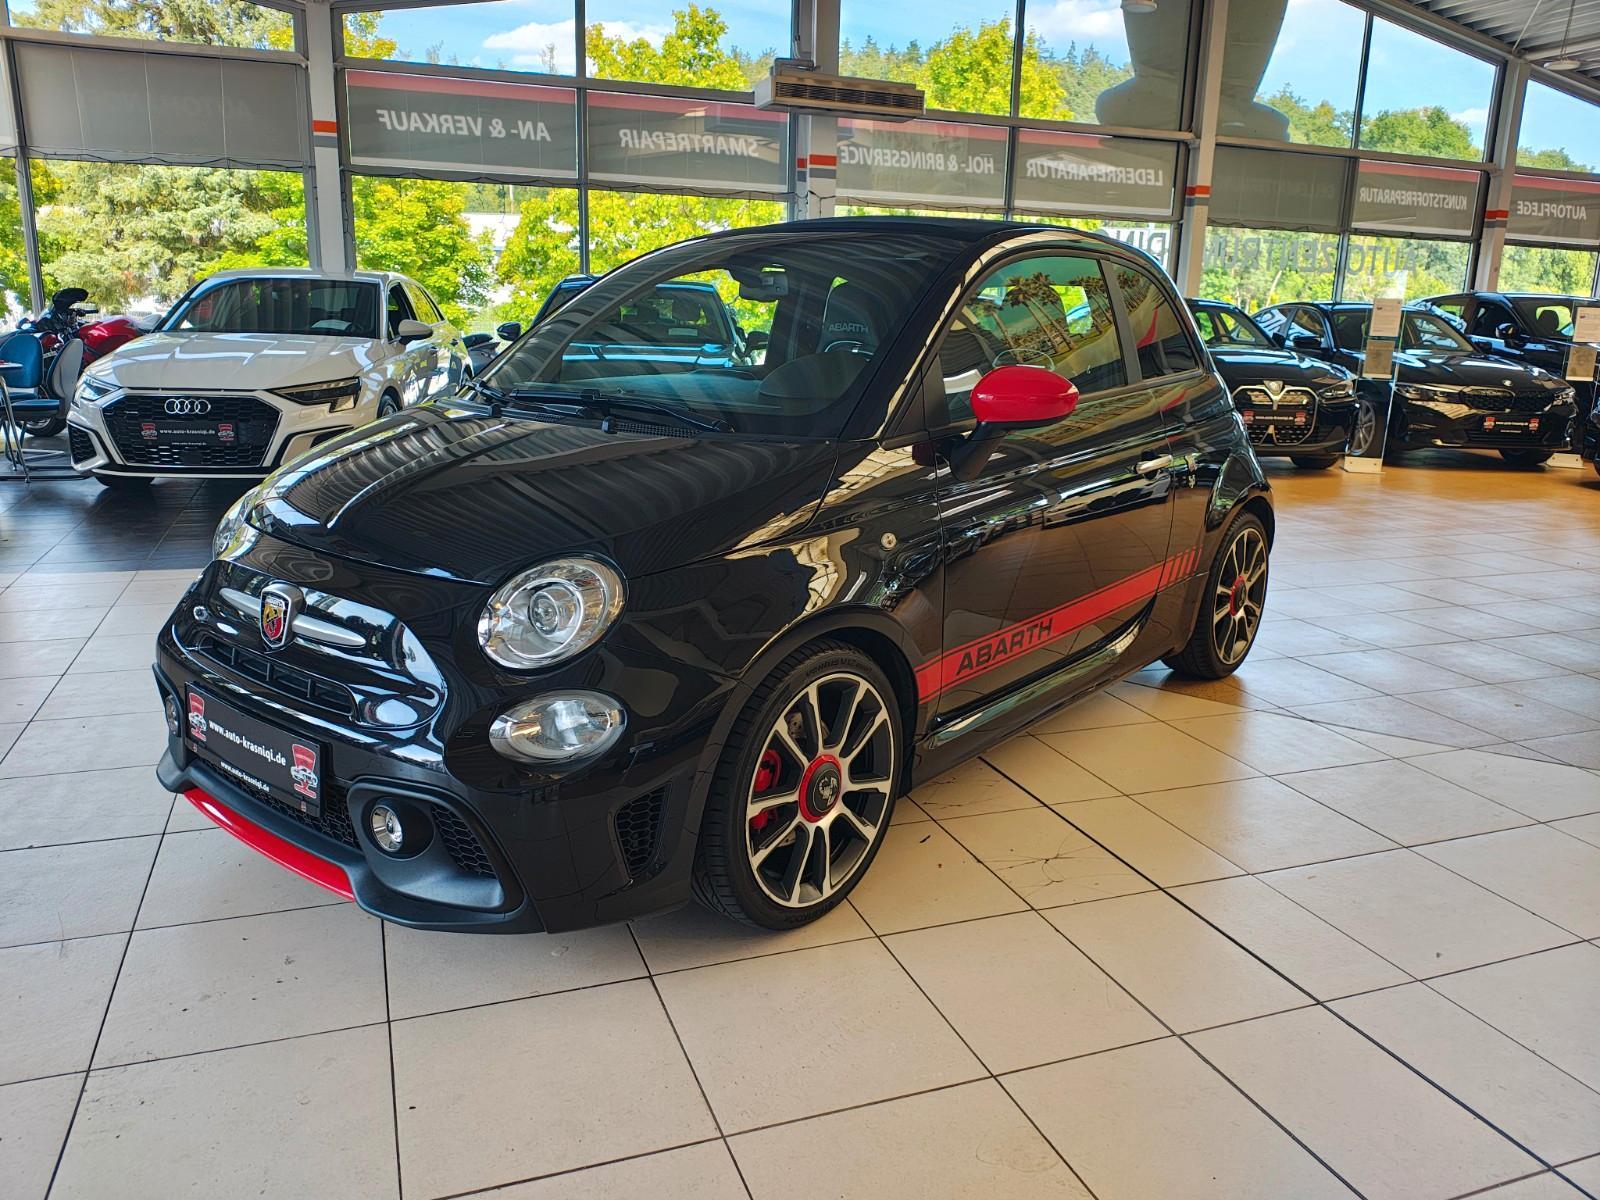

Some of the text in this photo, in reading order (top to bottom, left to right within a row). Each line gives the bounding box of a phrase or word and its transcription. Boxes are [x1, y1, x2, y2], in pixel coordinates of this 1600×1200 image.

[829, 322, 869, 333] ABARTH
[956, 617, 1053, 676] ABARTH
[208, 719, 287, 767] www.auto-krasniqi.de
